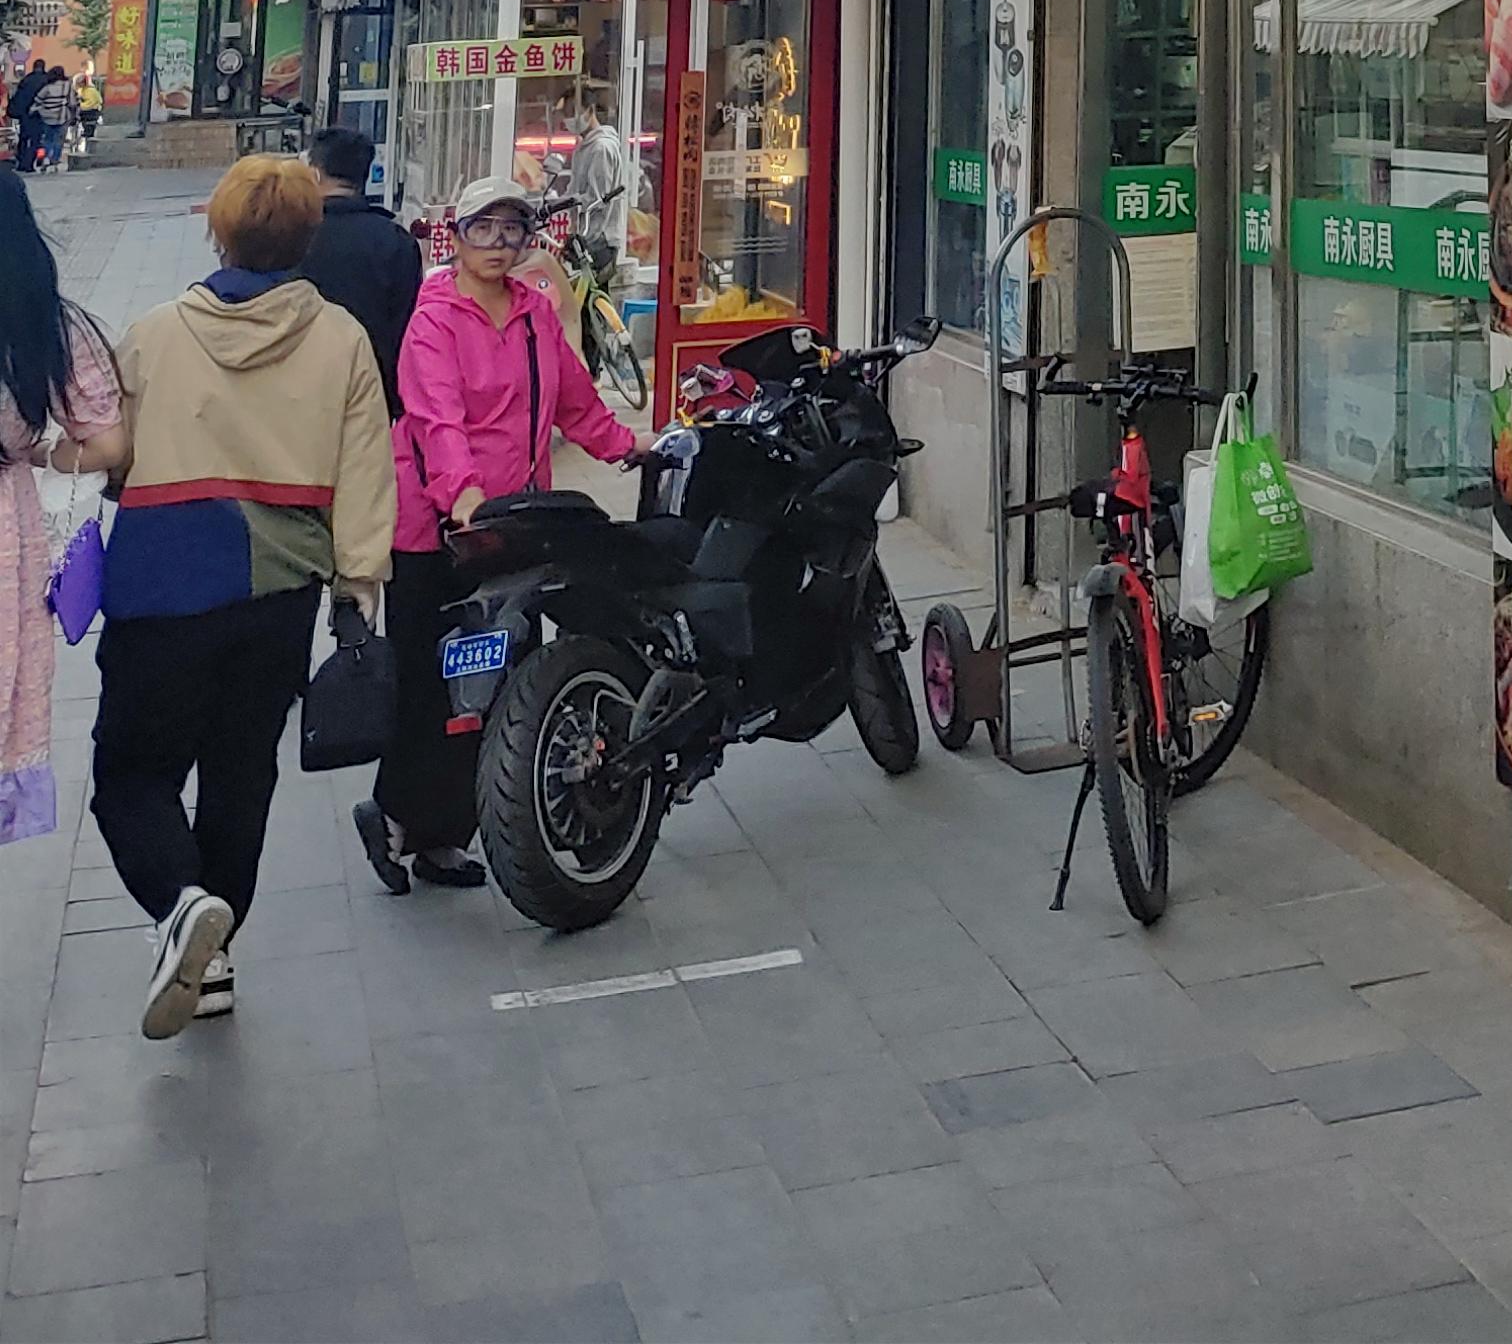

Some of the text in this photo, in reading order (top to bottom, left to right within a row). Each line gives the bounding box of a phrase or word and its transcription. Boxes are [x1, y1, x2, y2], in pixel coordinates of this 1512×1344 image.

[436, 41, 576, 78] 韩国金鱼饼
[1323, 216, 1394, 272] 南永厨具
